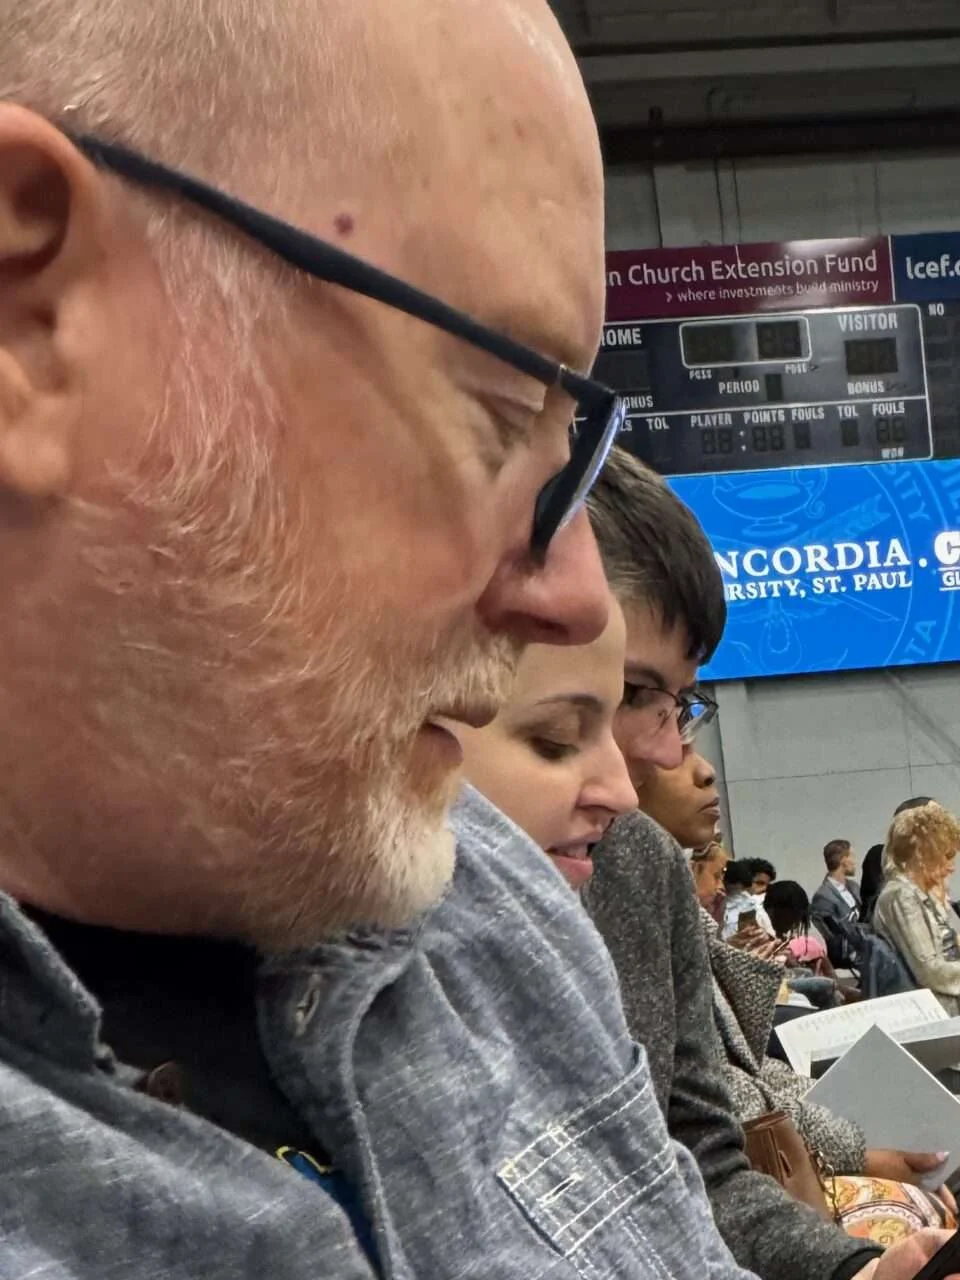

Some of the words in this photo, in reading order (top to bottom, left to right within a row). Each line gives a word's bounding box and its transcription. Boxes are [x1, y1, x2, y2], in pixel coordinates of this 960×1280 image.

[628, 259, 705, 286] Church
[711, 255, 818, 280] Extension
[825, 249, 877, 273] Fund
[677, 287, 716, 303] where
[719, 284, 793, 300] investments
[829, 279, 879, 294] ministry
[837, 312, 898, 332] VISITOR
[718, 379, 760, 394] PERIOD
[847, 380, 885, 395] BONUS
[622, 395, 654, 409] ONUS
[872, 402, 905, 416] FOULS
[743, 408, 785, 424] POINTS
[791, 407, 825, 421] FOULS
[837, 405, 859, 419] TOL
[646, 417, 670, 431] TOL
[690, 413, 732, 428] PLAYER
[713, 537, 911, 578] NCORDIA
[726, 578, 807, 602] RSITY,
[813, 574, 846, 594] ST.
[854, 570, 912, 593] PAUL
